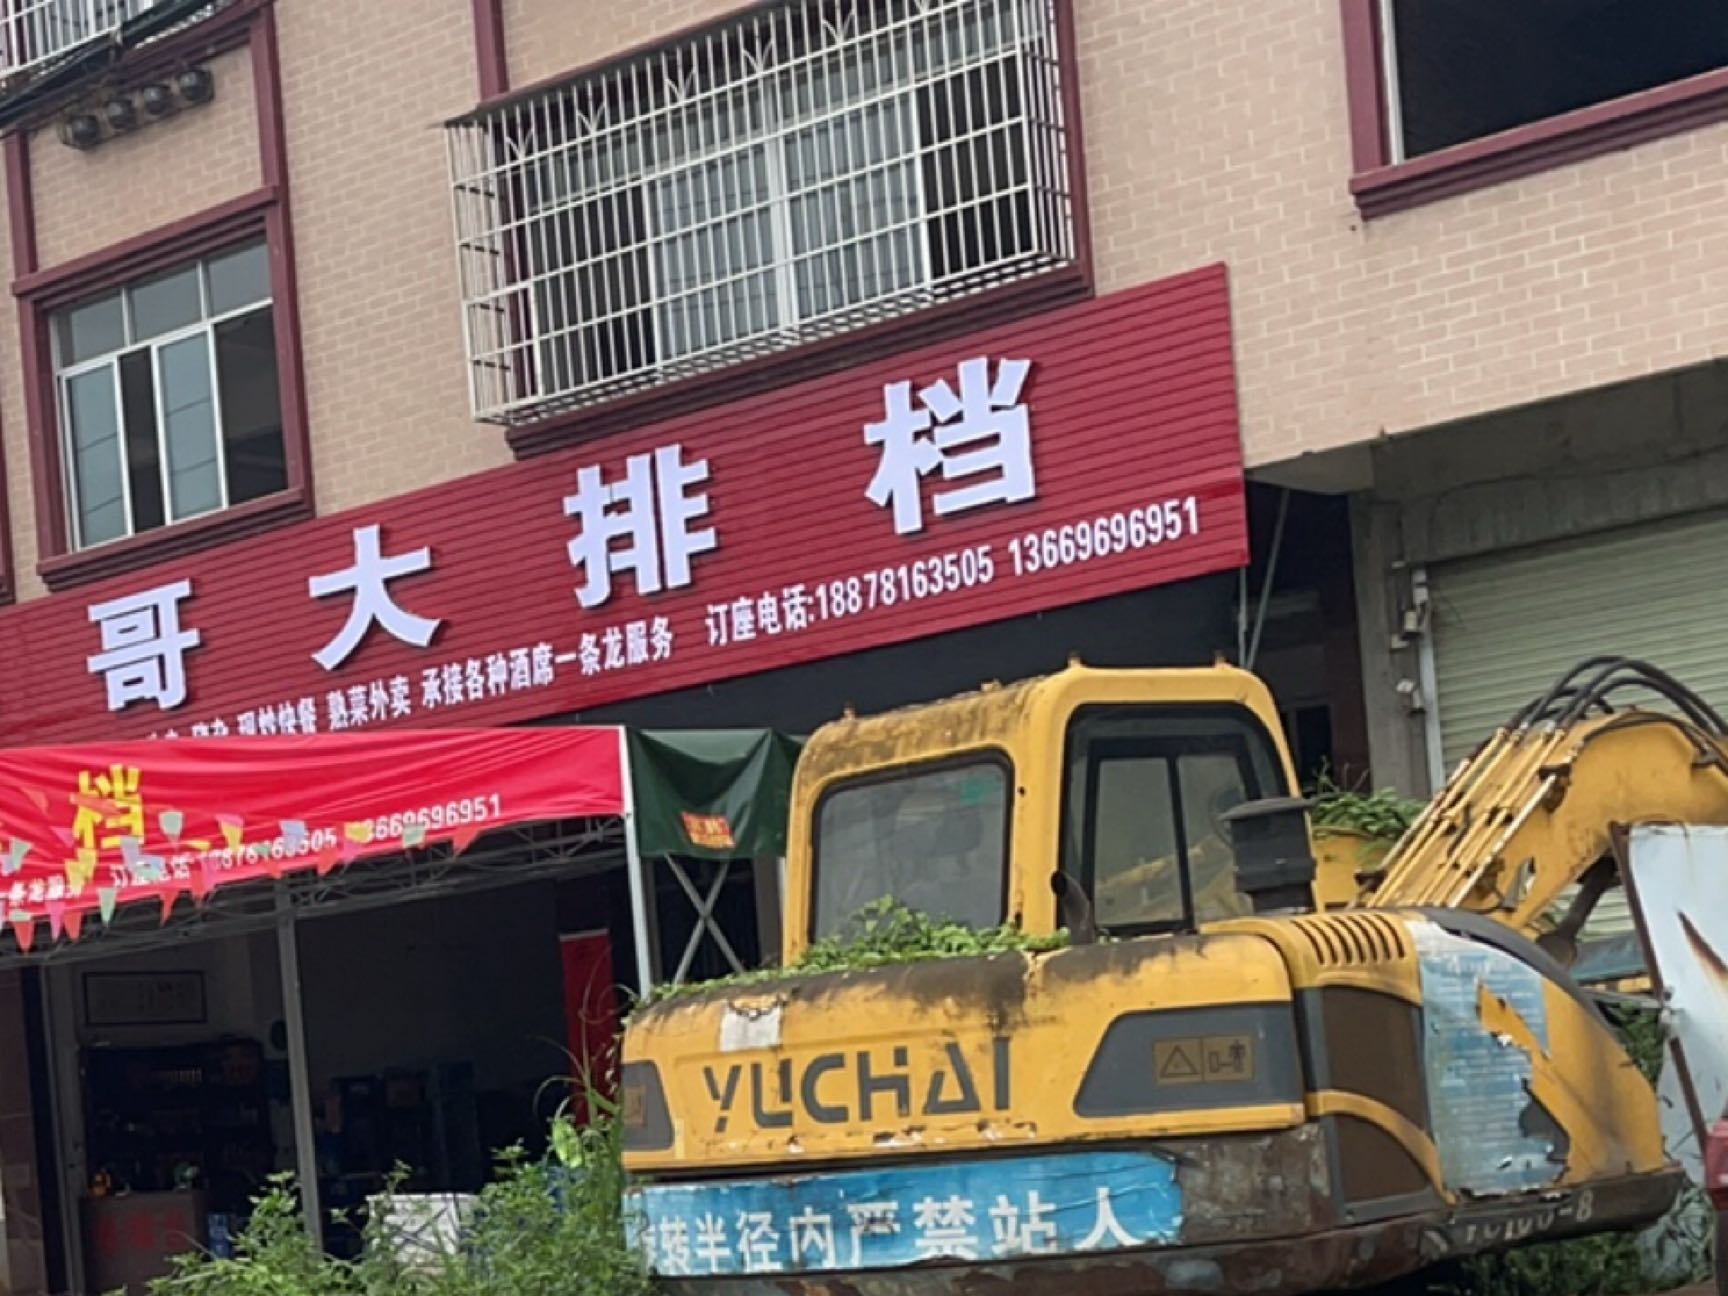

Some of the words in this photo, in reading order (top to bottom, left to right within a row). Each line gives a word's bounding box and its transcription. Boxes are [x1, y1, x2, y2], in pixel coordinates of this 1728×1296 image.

[421, 616, 674, 709] 承接各种酒席一条龙服务
[1007, 496, 1200, 578] 13669696951
[702, 1036, 1012, 1133] YUCHAI
